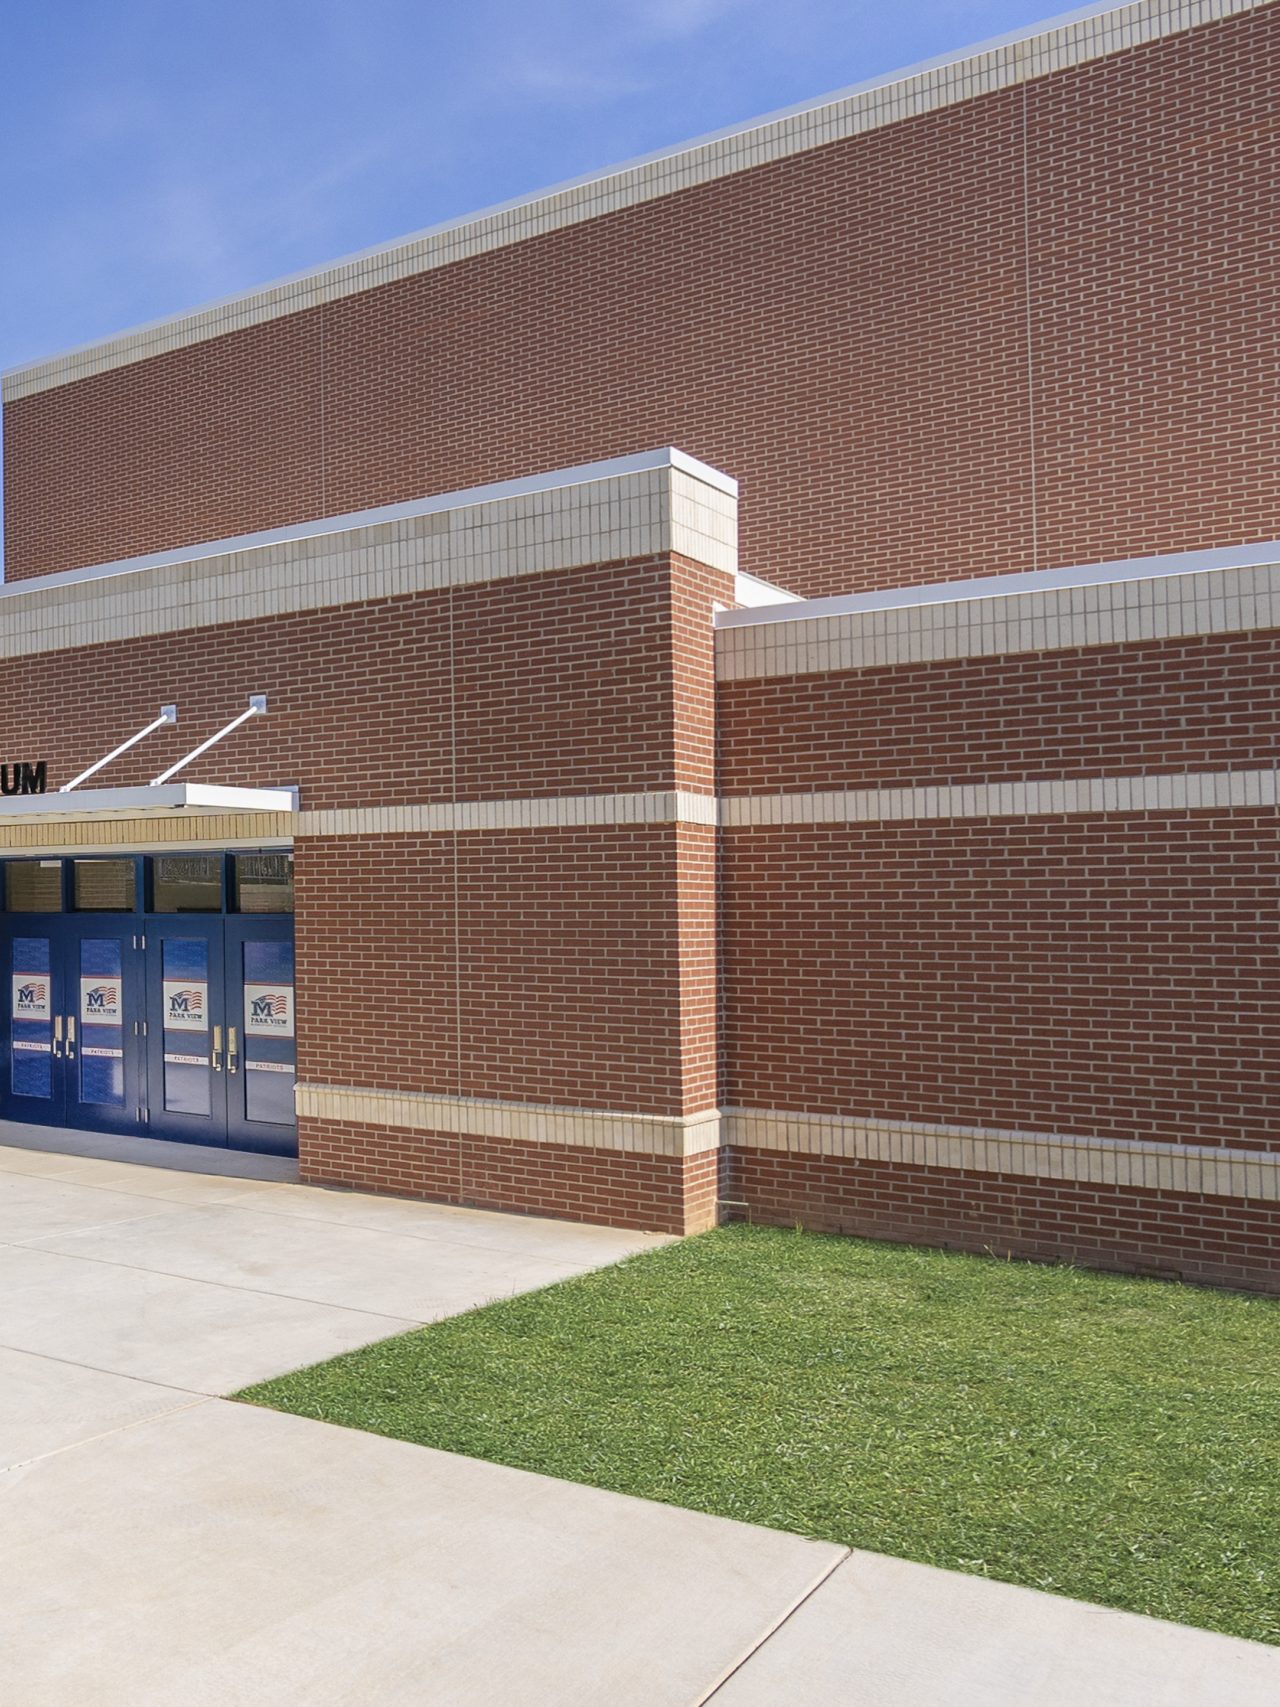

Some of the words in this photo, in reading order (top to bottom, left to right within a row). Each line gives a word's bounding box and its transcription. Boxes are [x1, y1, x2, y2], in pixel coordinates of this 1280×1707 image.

[17, 989, 35, 1003] M
[86, 992, 105, 1007] M
[169, 996, 191, 1012] M
[251, 1001, 273, 1017] M
[255, 1063, 284, 1071] PATRIOTS
